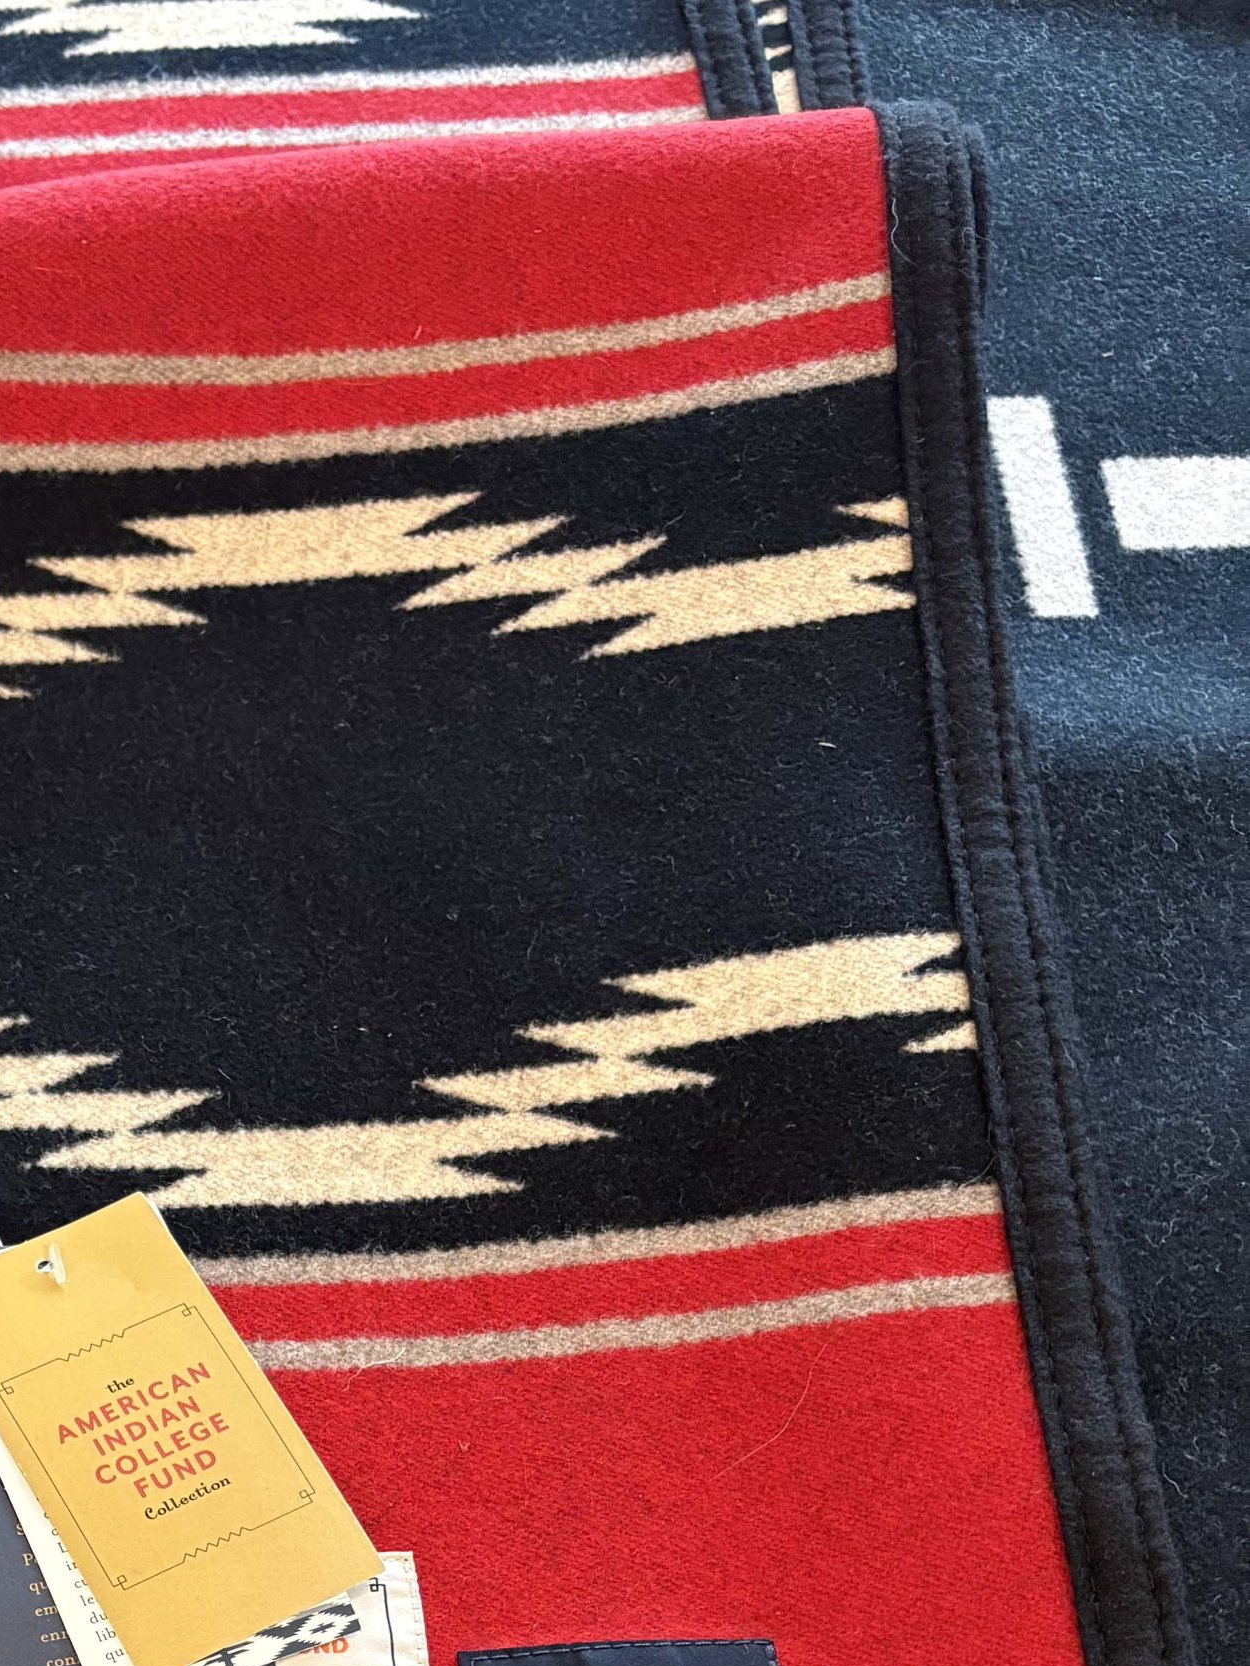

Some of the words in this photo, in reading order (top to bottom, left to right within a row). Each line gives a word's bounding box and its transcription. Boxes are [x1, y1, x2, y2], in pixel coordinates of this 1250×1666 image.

[58, 1362, 211, 1445] AMERICAN
[106, 1377, 135, 1394] the
[92, 1396, 201, 1456] INDIAN
[95, 1412, 230, 1485] COLLEGE
[133, 1449, 217, 1499] FUND
[144, 1477, 232, 1520] Collection
